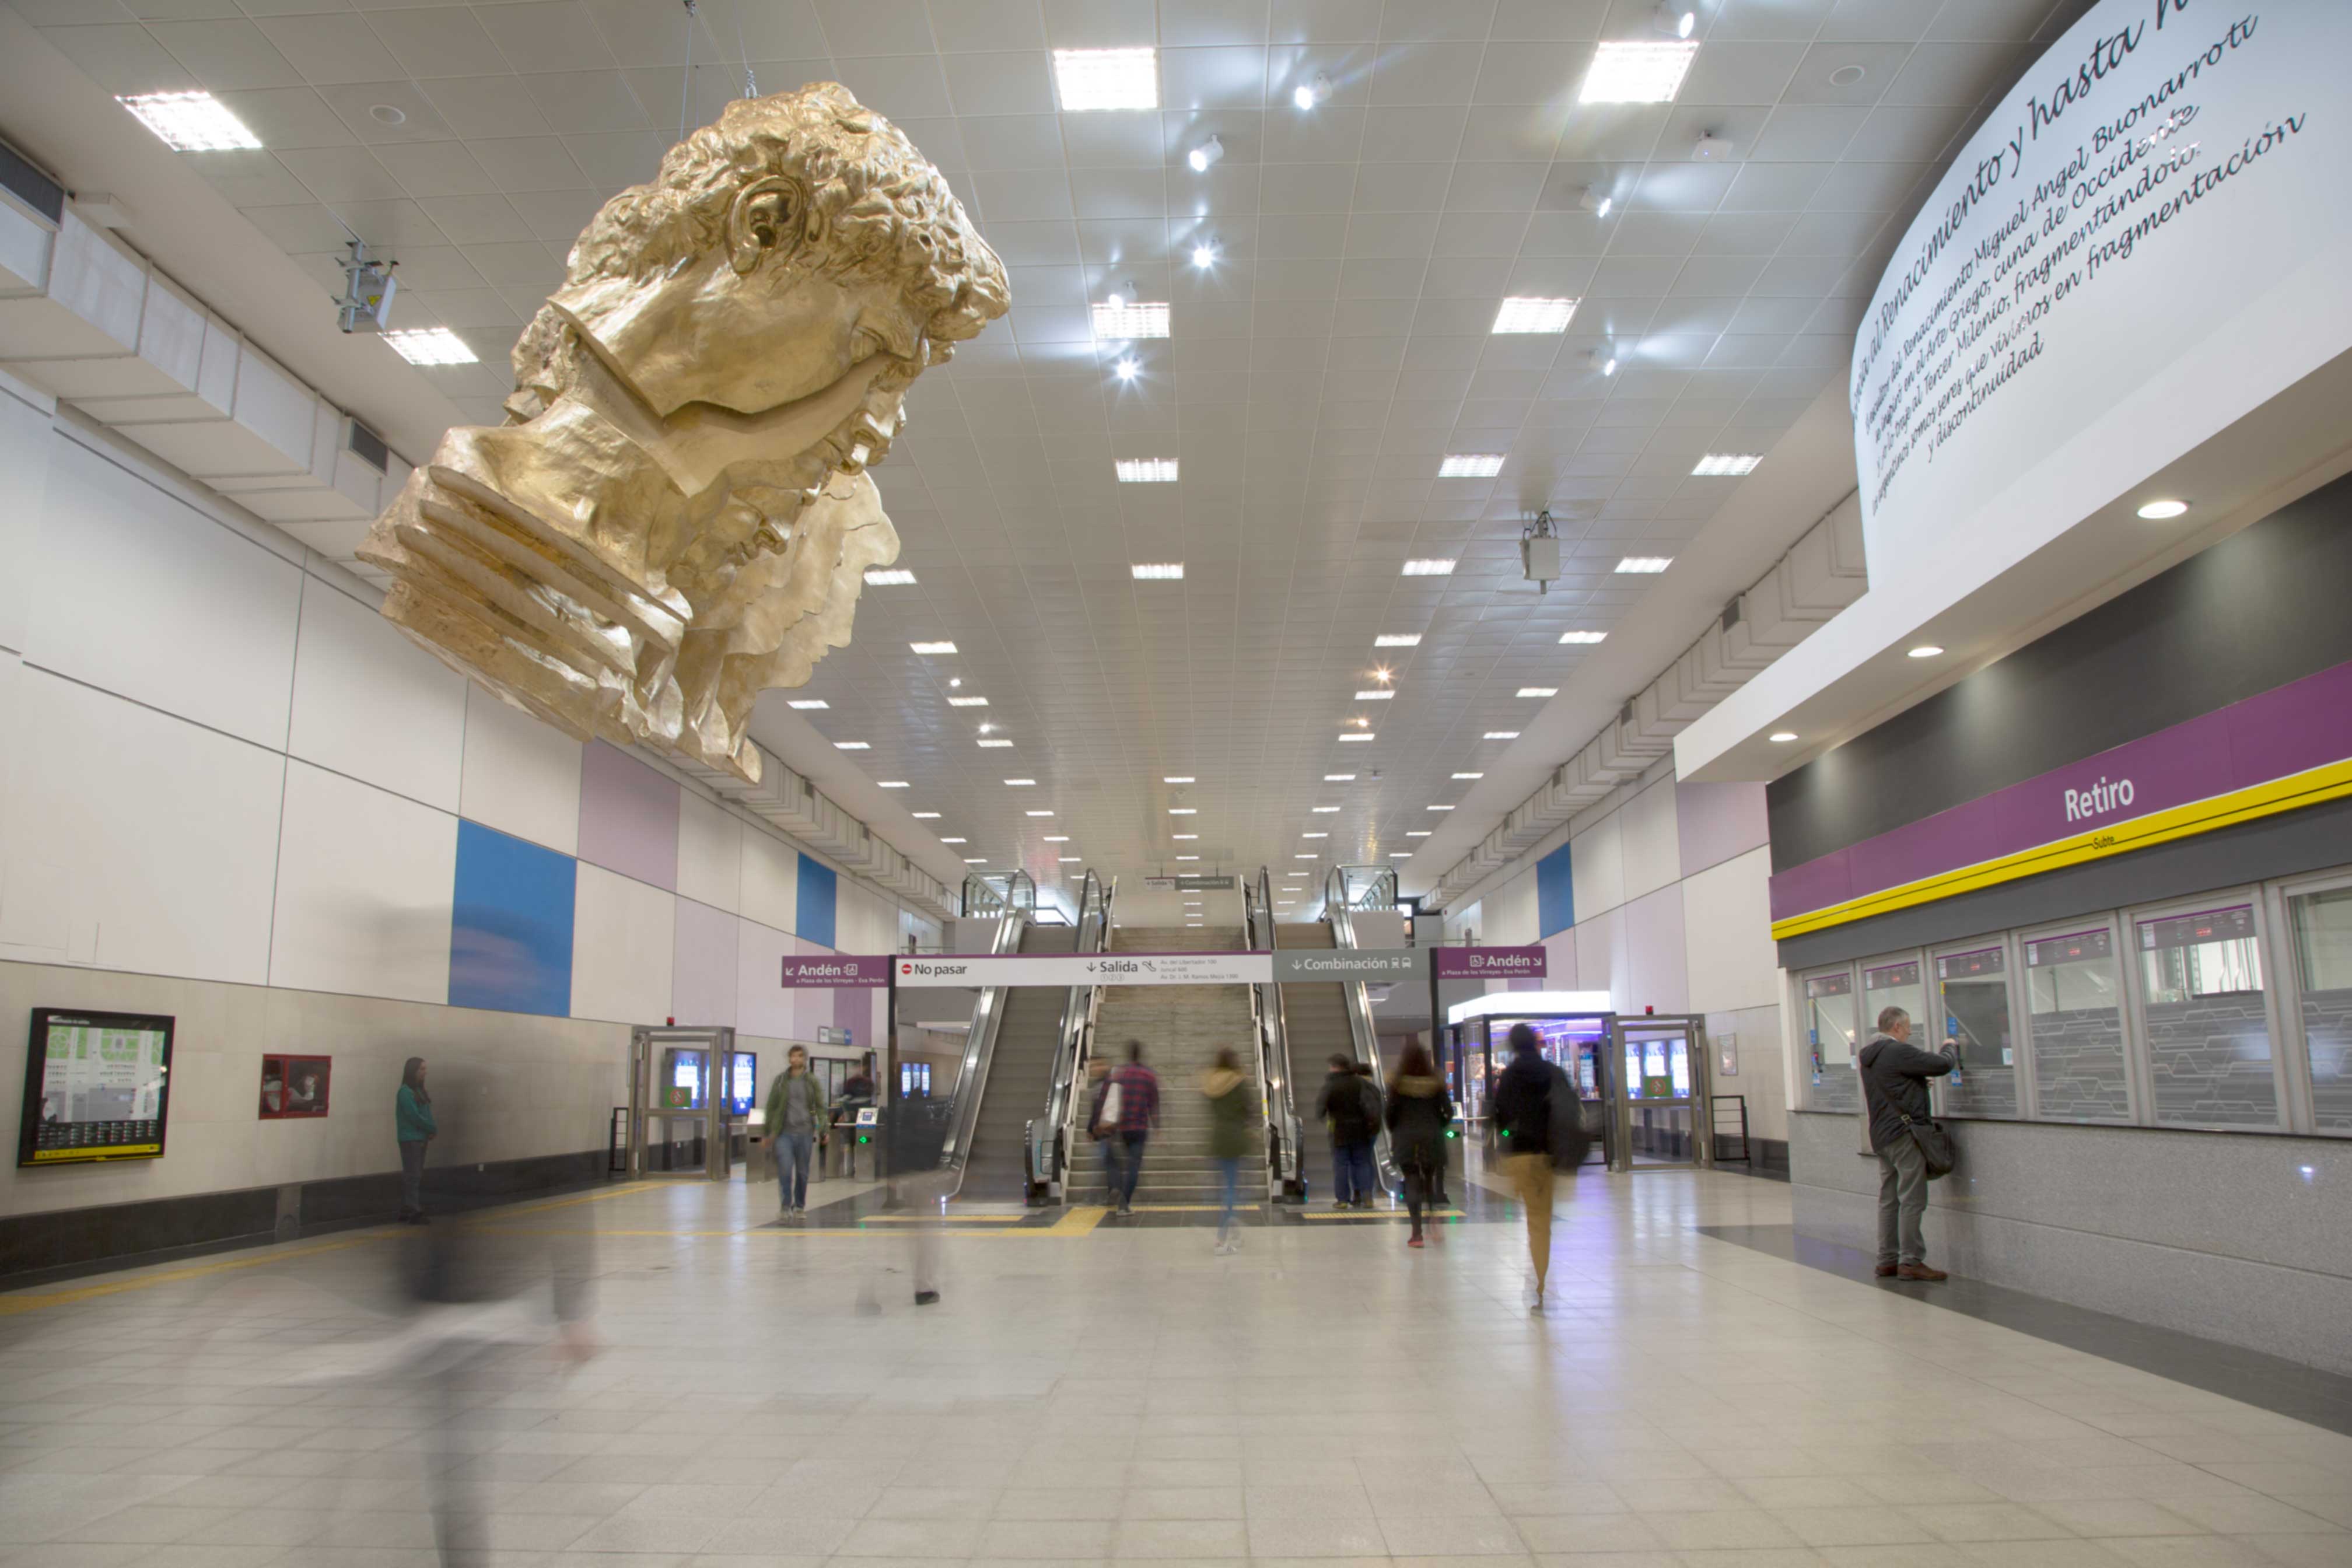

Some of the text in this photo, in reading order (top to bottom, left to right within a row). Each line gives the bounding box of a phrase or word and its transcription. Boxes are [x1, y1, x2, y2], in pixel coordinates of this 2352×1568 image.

[1870, 318, 1883, 364] al
[1881, 148, 2006, 339] Renacimiento
[2009, 125, 2023, 178] y
[2027, 19, 2145, 141] hasta
[1891, 351, 1902, 383] del
[1903, 258, 1973, 361] Renacimiento
[1975, 199, 2029, 268] Miguel
[2092, 14, 2259, 153] Buonarroti
[1904, 369, 1915, 393] en
[1916, 348, 1926, 374] el
[1927, 328, 1948, 362] Arte
[1950, 278, 1990, 334] Griego,
[1994, 231, 2039, 282] cuna
[2043, 204, 2068, 237] de
[2073, 106, 2200, 209] Occidente
[1911, 407, 1937, 450] somos
[1938, 378, 1964, 416] seres
[1965, 352, 1989, 390] que
[1990, 293, 2052, 358] vivimos
[2055, 270, 2082, 300] en
[2087, 113, 2306, 279] fragmentación
[1912, 384, 1923, 412] al
[1924, 350, 1954, 396] Tercer
[1957, 295, 2011, 357] Milenio,
[1928, 331, 2045, 464] y discontinuidad
[2065, 776, 2134, 822] Retiro
[2092, 836, 2115, 850] Subte
[798, 963, 841, 976] Andén
[915, 964, 967, 977] No pasar
[1100, 961, 1138, 973] Salida
[1304, 957, 1388, 970] Combinación
[1486, 954, 1530, 967] Andén
